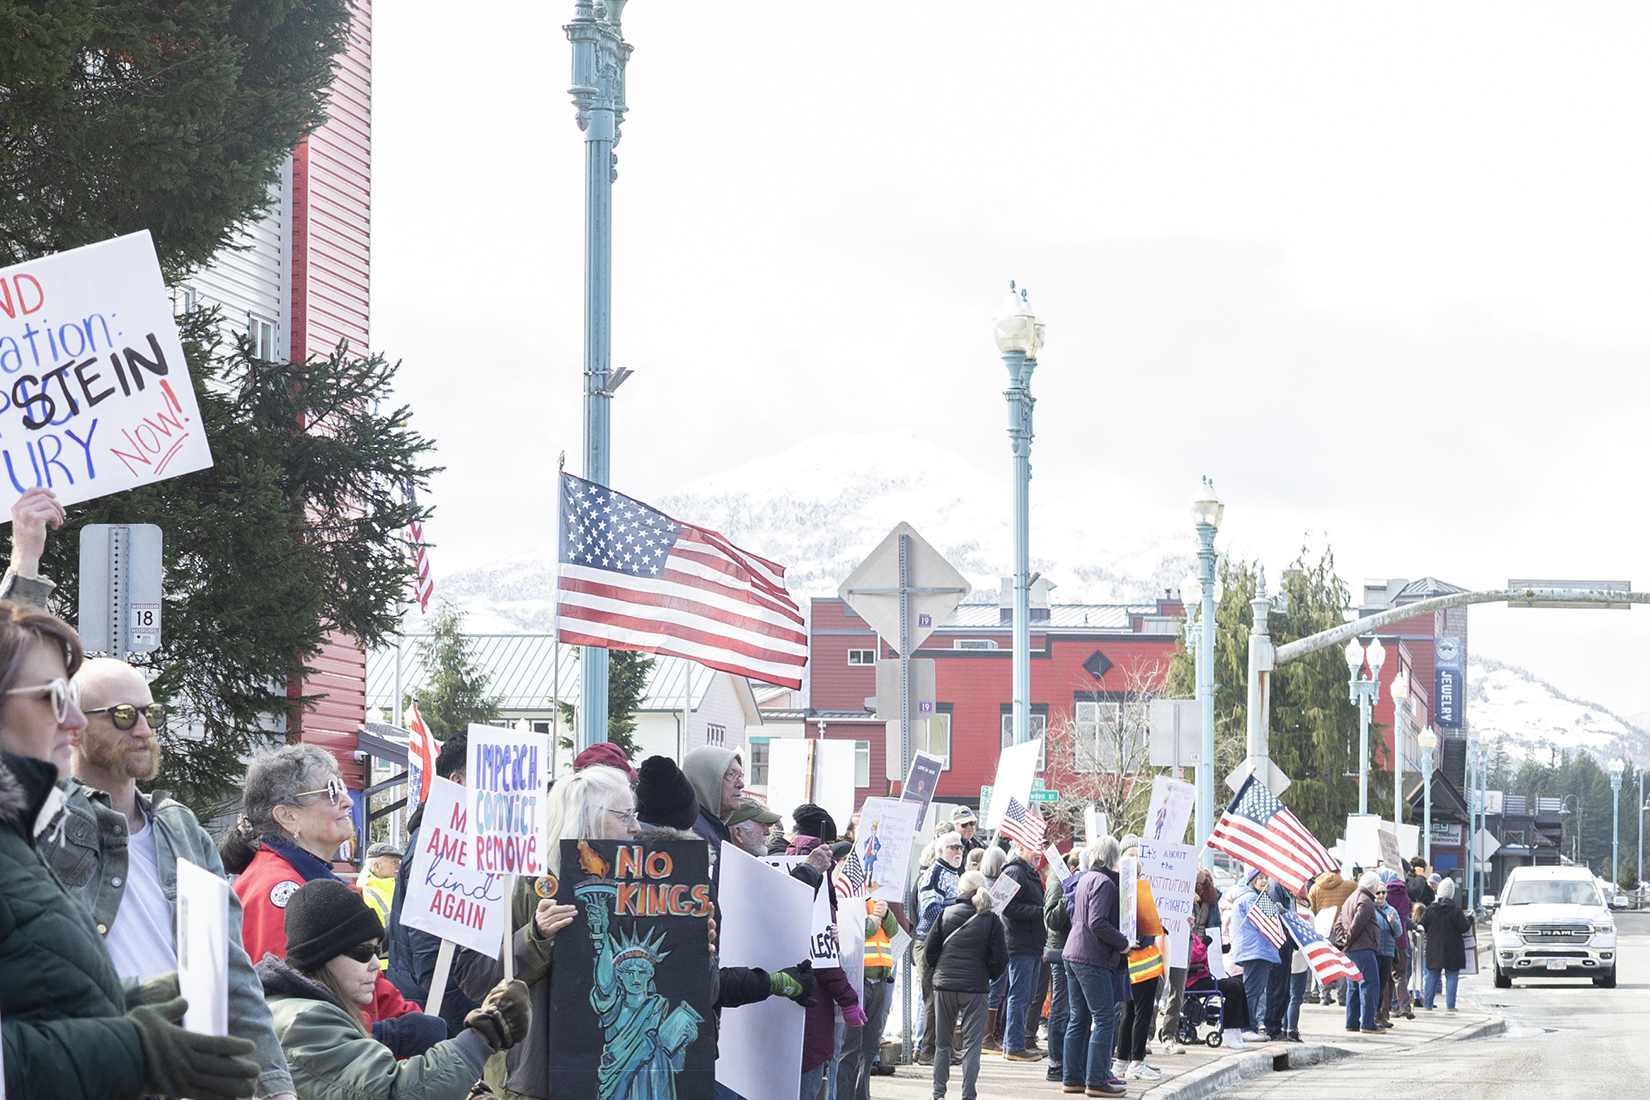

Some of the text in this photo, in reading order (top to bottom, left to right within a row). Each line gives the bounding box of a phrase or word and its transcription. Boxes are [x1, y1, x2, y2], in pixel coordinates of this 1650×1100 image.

[110, 379, 191, 478] NOW!
[136, 610, 153, 626] 18
[1441, 671, 1452, 721] JEWELRY
[614, 845, 674, 879] NO
[1139, 844, 1187, 860] It's ABOUT
[1161, 861, 1173, 870] the
[425, 850, 502, 901] kind
[429, 889, 486, 931] AGAIN
[614, 881, 710, 917] KINGS
[1155, 896, 1190, 914] OF RIGHTS
[810, 925, 837, 960] LES?
